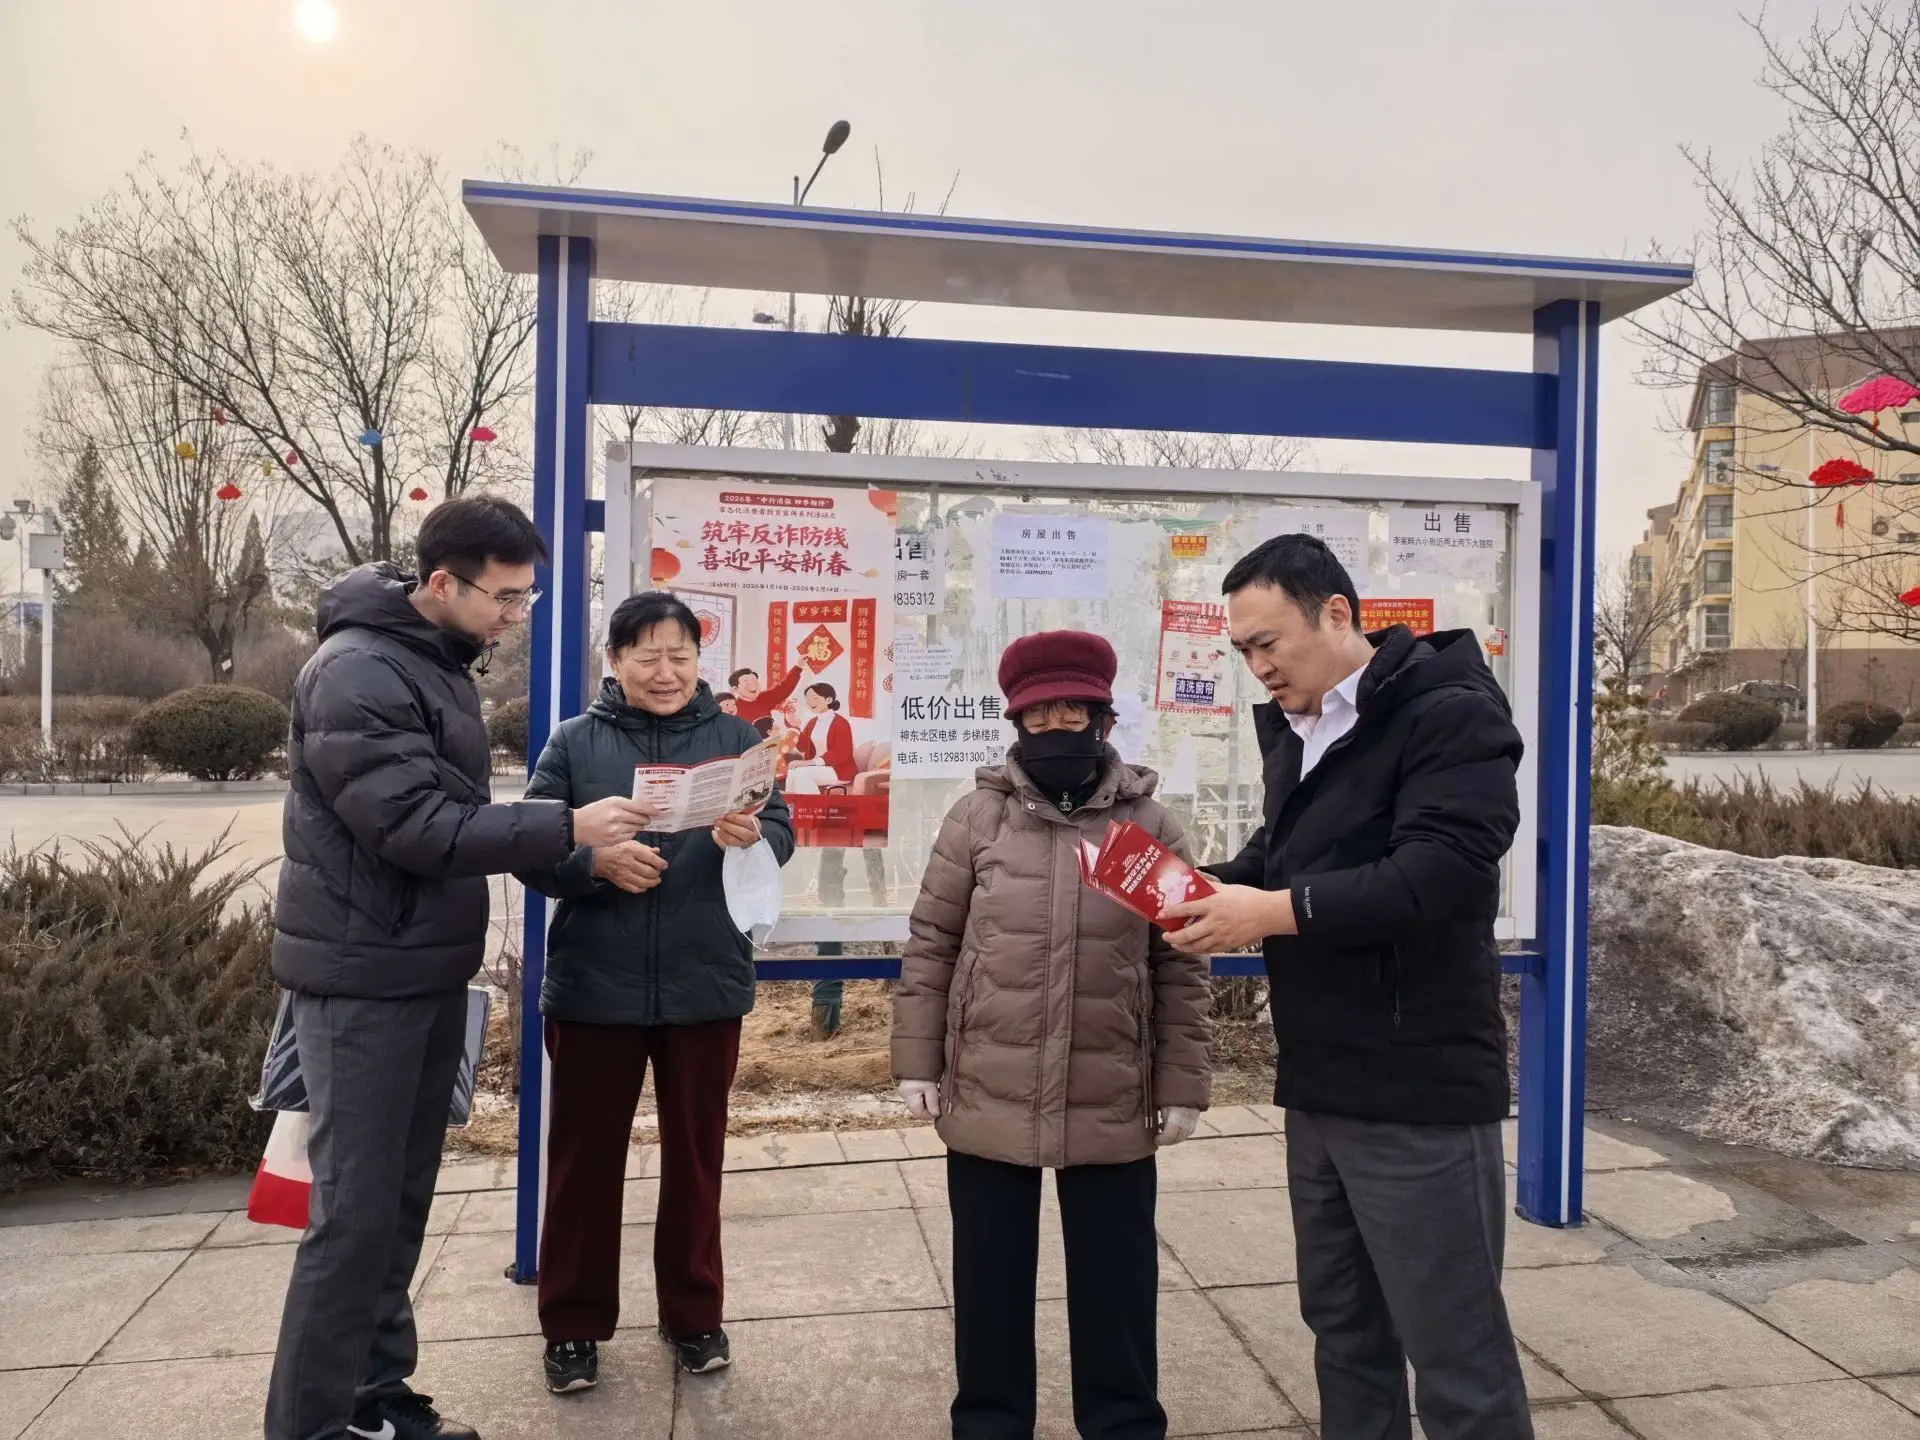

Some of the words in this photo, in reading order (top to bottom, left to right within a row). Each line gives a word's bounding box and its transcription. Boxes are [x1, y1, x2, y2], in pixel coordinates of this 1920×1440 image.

[1301, 524, 1326, 533] 出售
[1424, 511, 1472, 533] 出售
[701, 520, 849, 550] 筑牢反诈防线
[1021, 529, 1077, 541] 房屋出售
[697, 545, 853, 577] 喜迎平安新春
[798, 606, 843, 617] 岁岁平安
[807, 634, 833, 663] 福
[1176, 679, 1214, 695] 清洗窗帘
[900, 694, 1001, 721] 低价出售
[899, 728, 958, 743] 神东北区电梯
[962, 728, 1000, 742] 步梯楼房
[897, 751, 986, 765] 电话：15129831300
